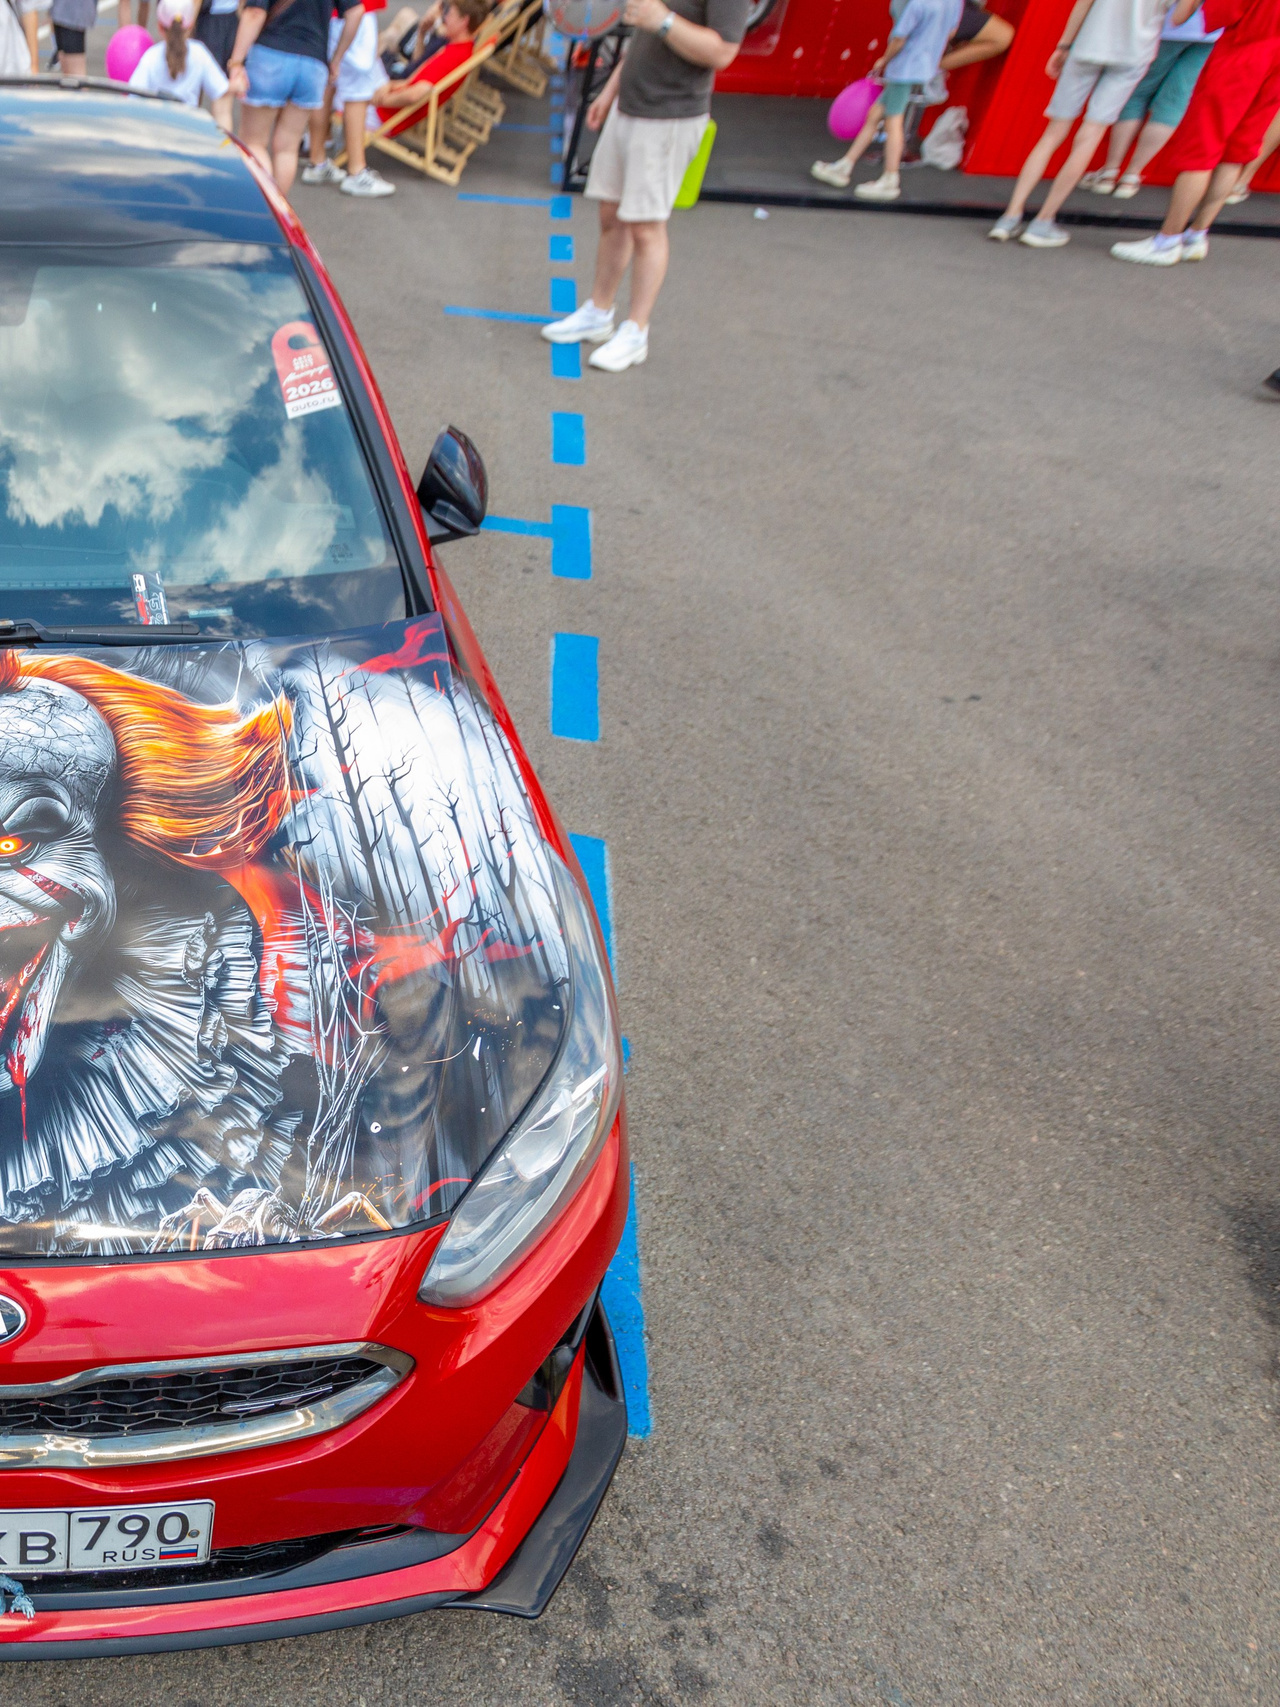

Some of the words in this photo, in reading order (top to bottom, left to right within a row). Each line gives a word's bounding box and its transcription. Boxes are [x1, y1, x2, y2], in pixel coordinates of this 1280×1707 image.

[286, 377, 334, 401] 2026
[291, 395, 335, 412] auto.ru
[78, 1511, 190, 1551] 790
[102, 1548, 156, 1563] RUS
